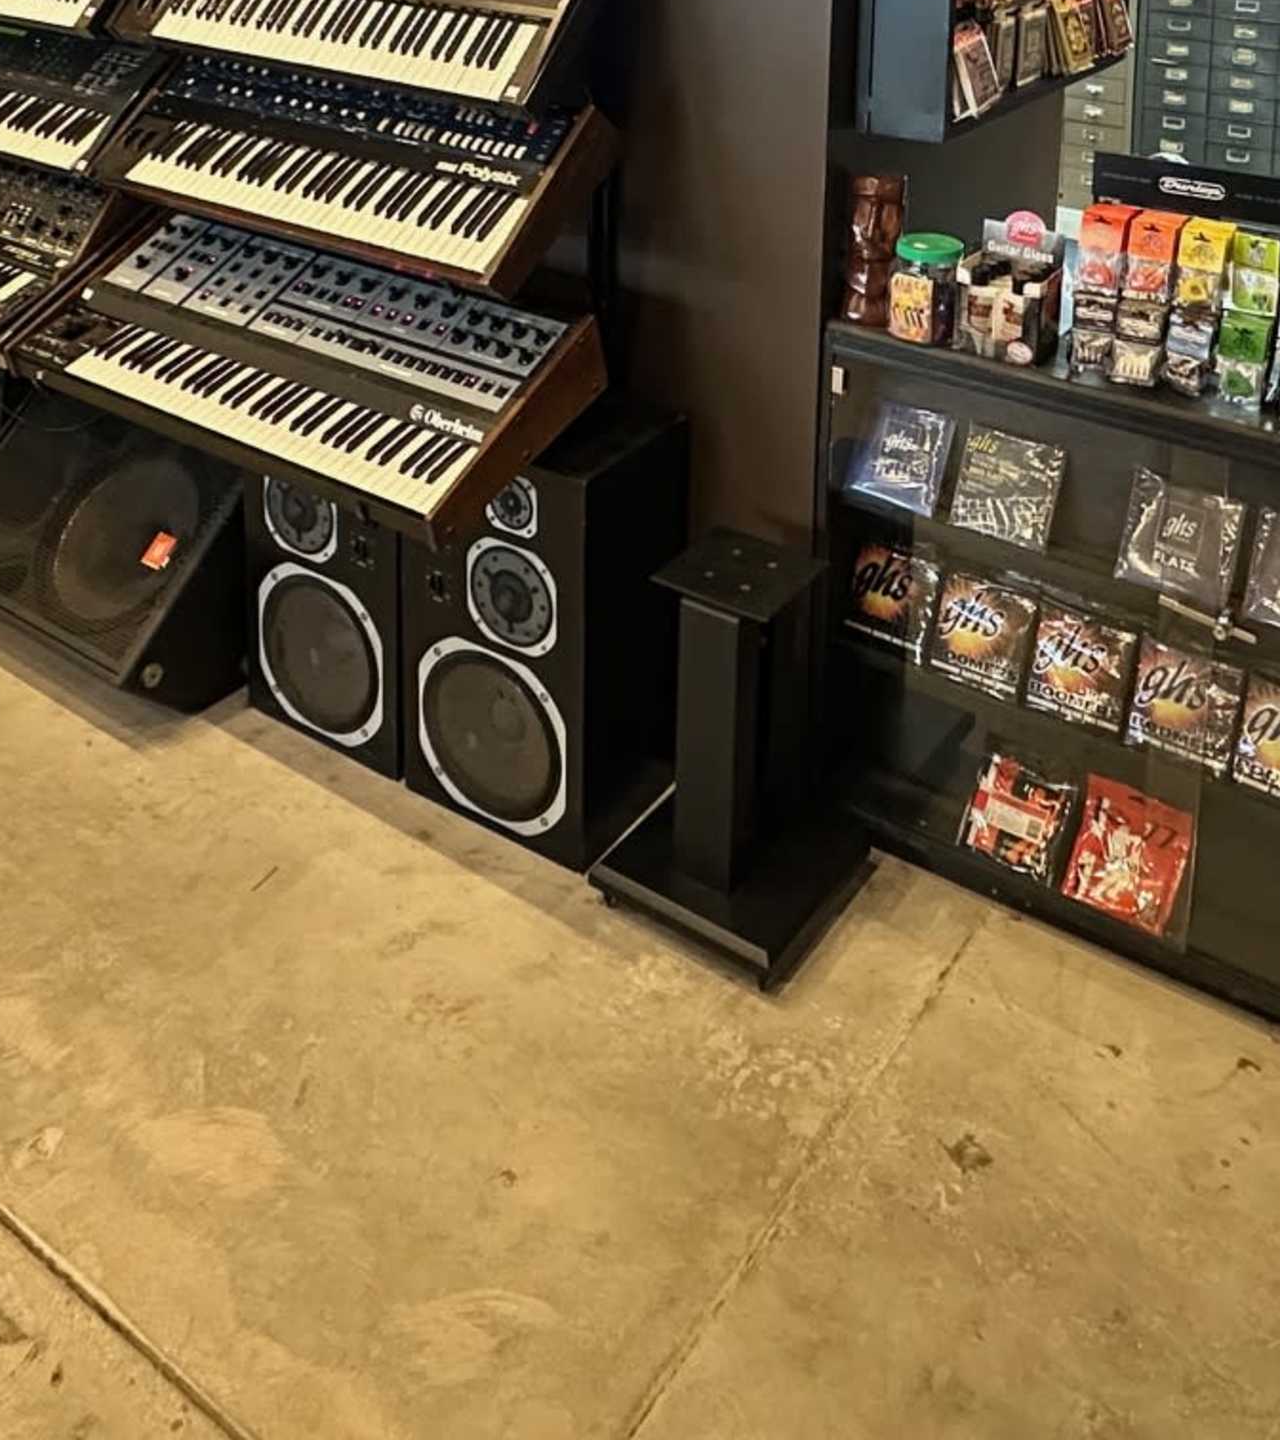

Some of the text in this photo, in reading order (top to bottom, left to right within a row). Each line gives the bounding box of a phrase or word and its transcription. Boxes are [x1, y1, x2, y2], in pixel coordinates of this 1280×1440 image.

[424, 408, 485, 444] Oberheim
[1162, 512, 1198, 540] ghs
[852, 557, 913, 601] ghs
[1135, 658, 1210, 709] ghs
